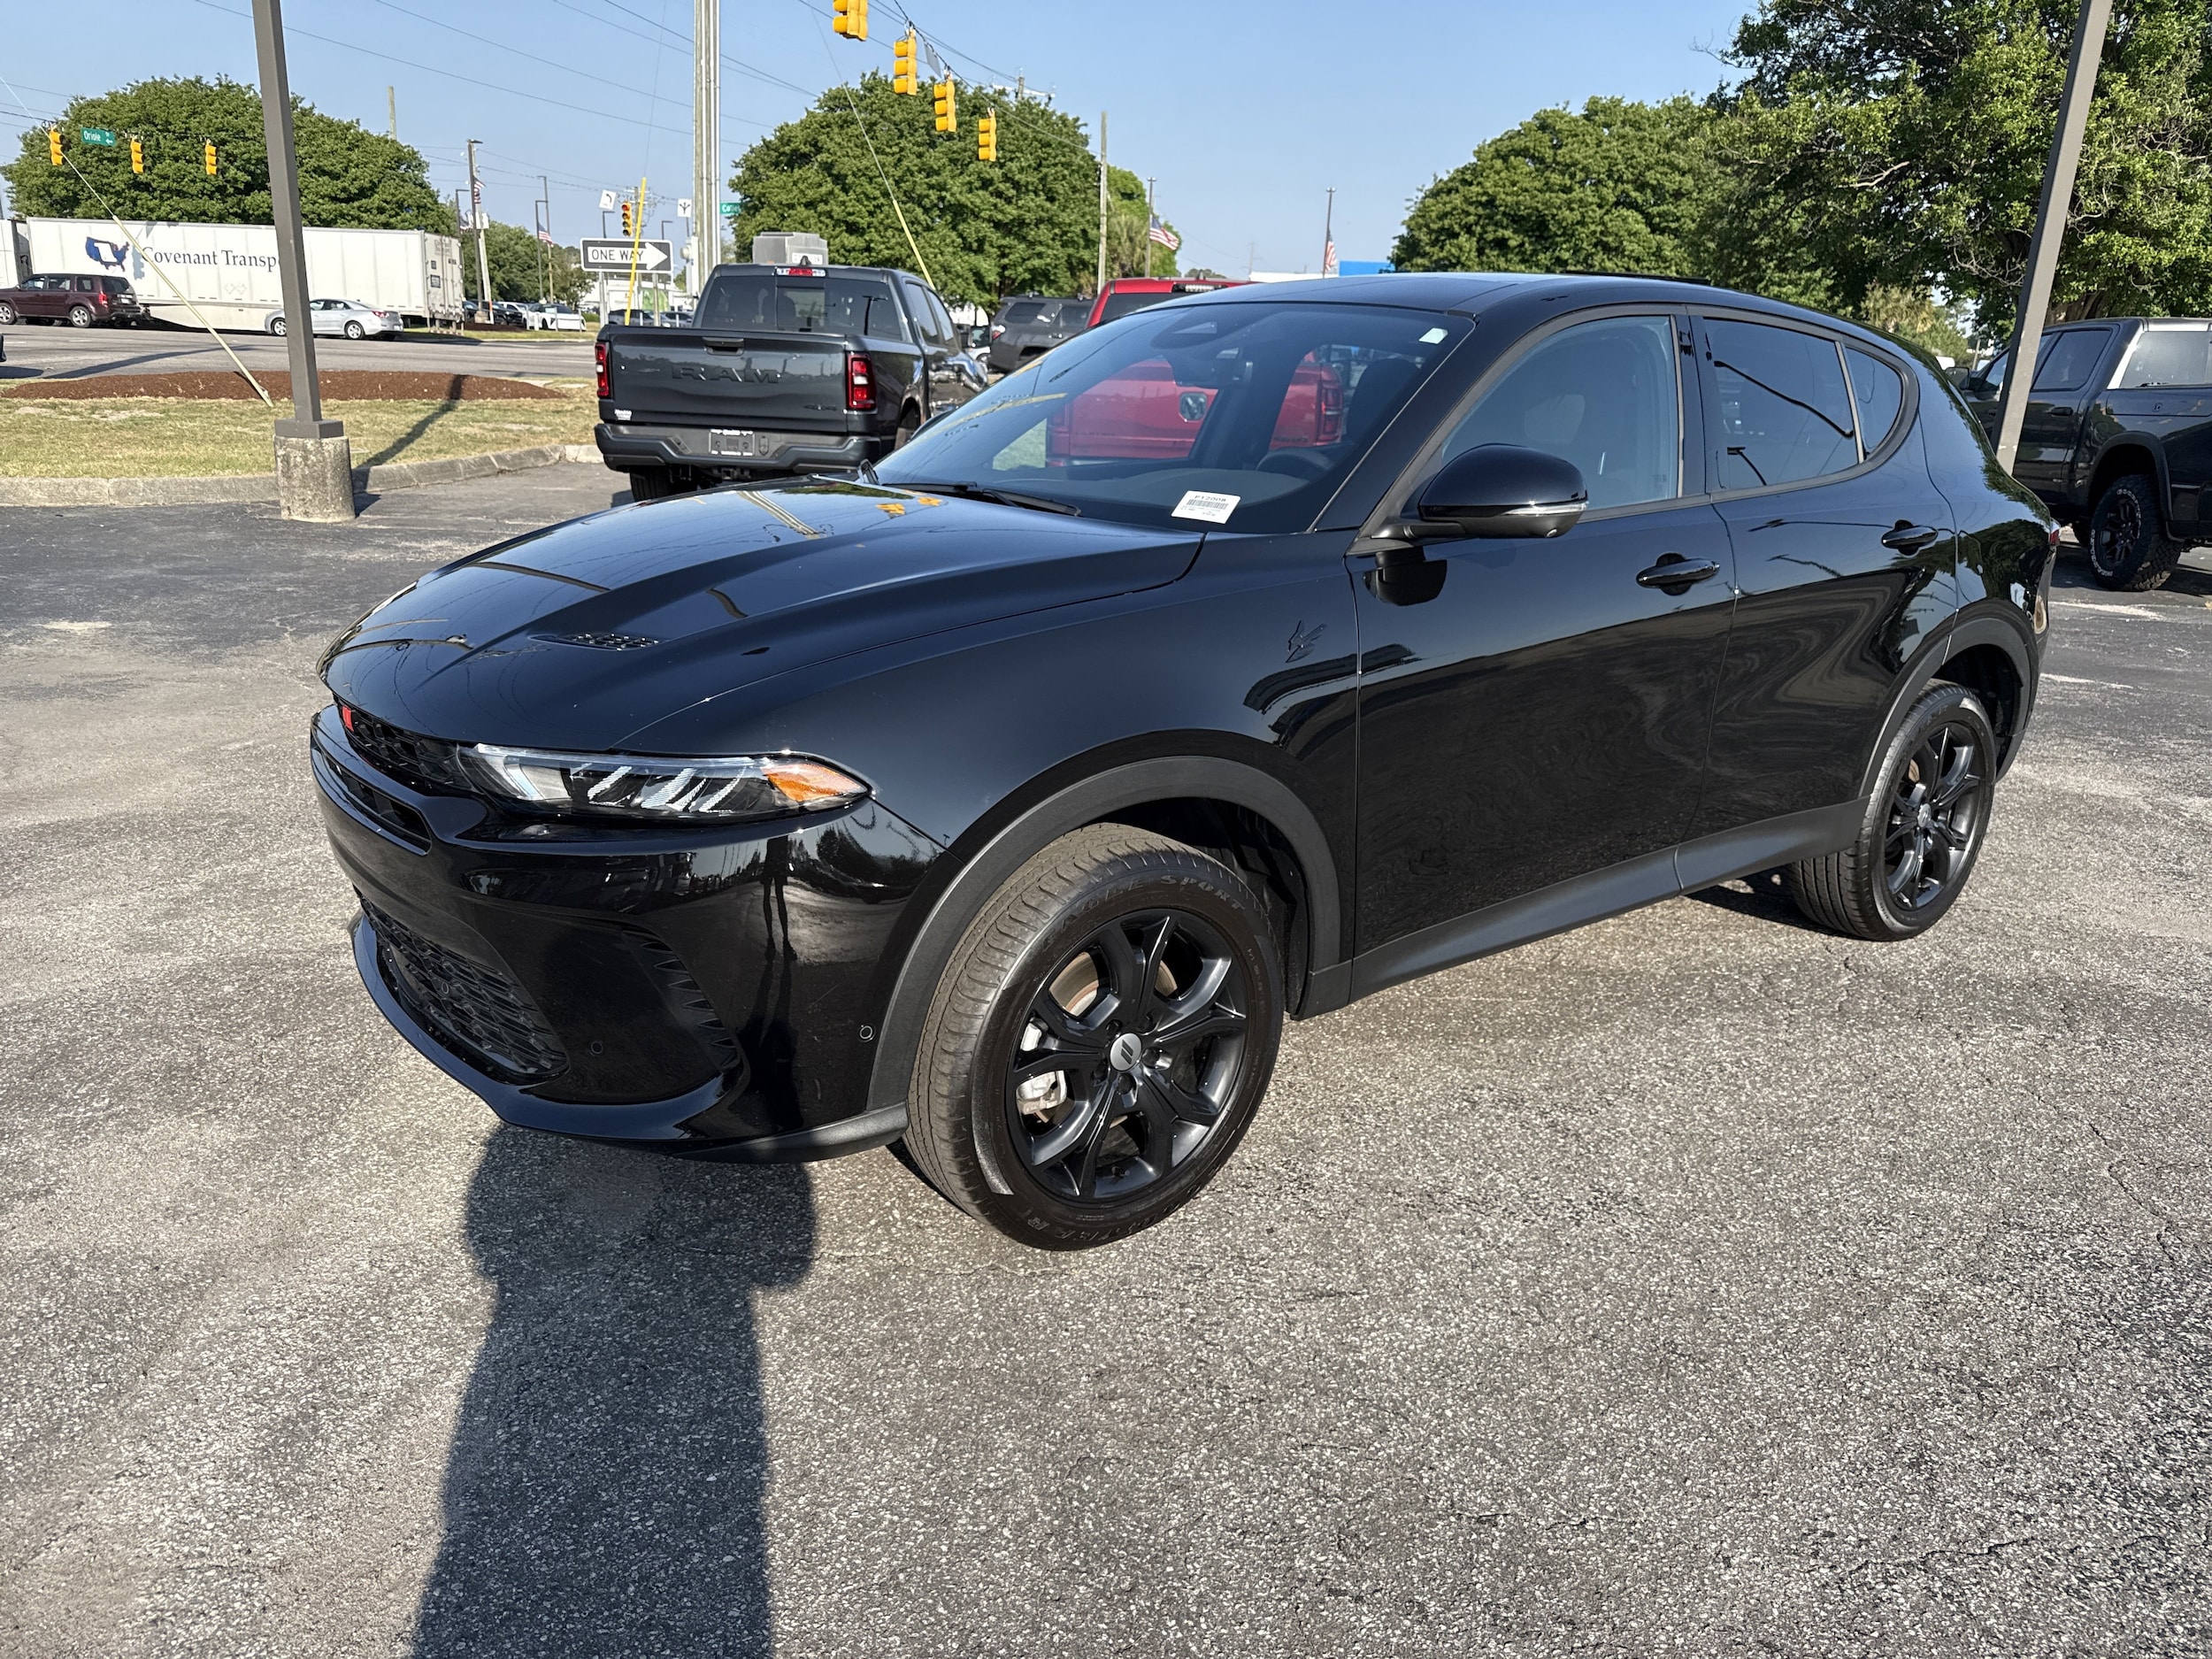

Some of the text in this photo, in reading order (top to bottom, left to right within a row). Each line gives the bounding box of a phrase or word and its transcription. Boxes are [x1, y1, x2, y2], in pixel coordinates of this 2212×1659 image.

[83, 130, 101, 142] Oriole
[142, 247, 280, 273] Covenant Transp
[591, 249, 644, 262] ONE WAY
[672, 365, 780, 384] RAM
[1159, 873, 1246, 910] SPORT
